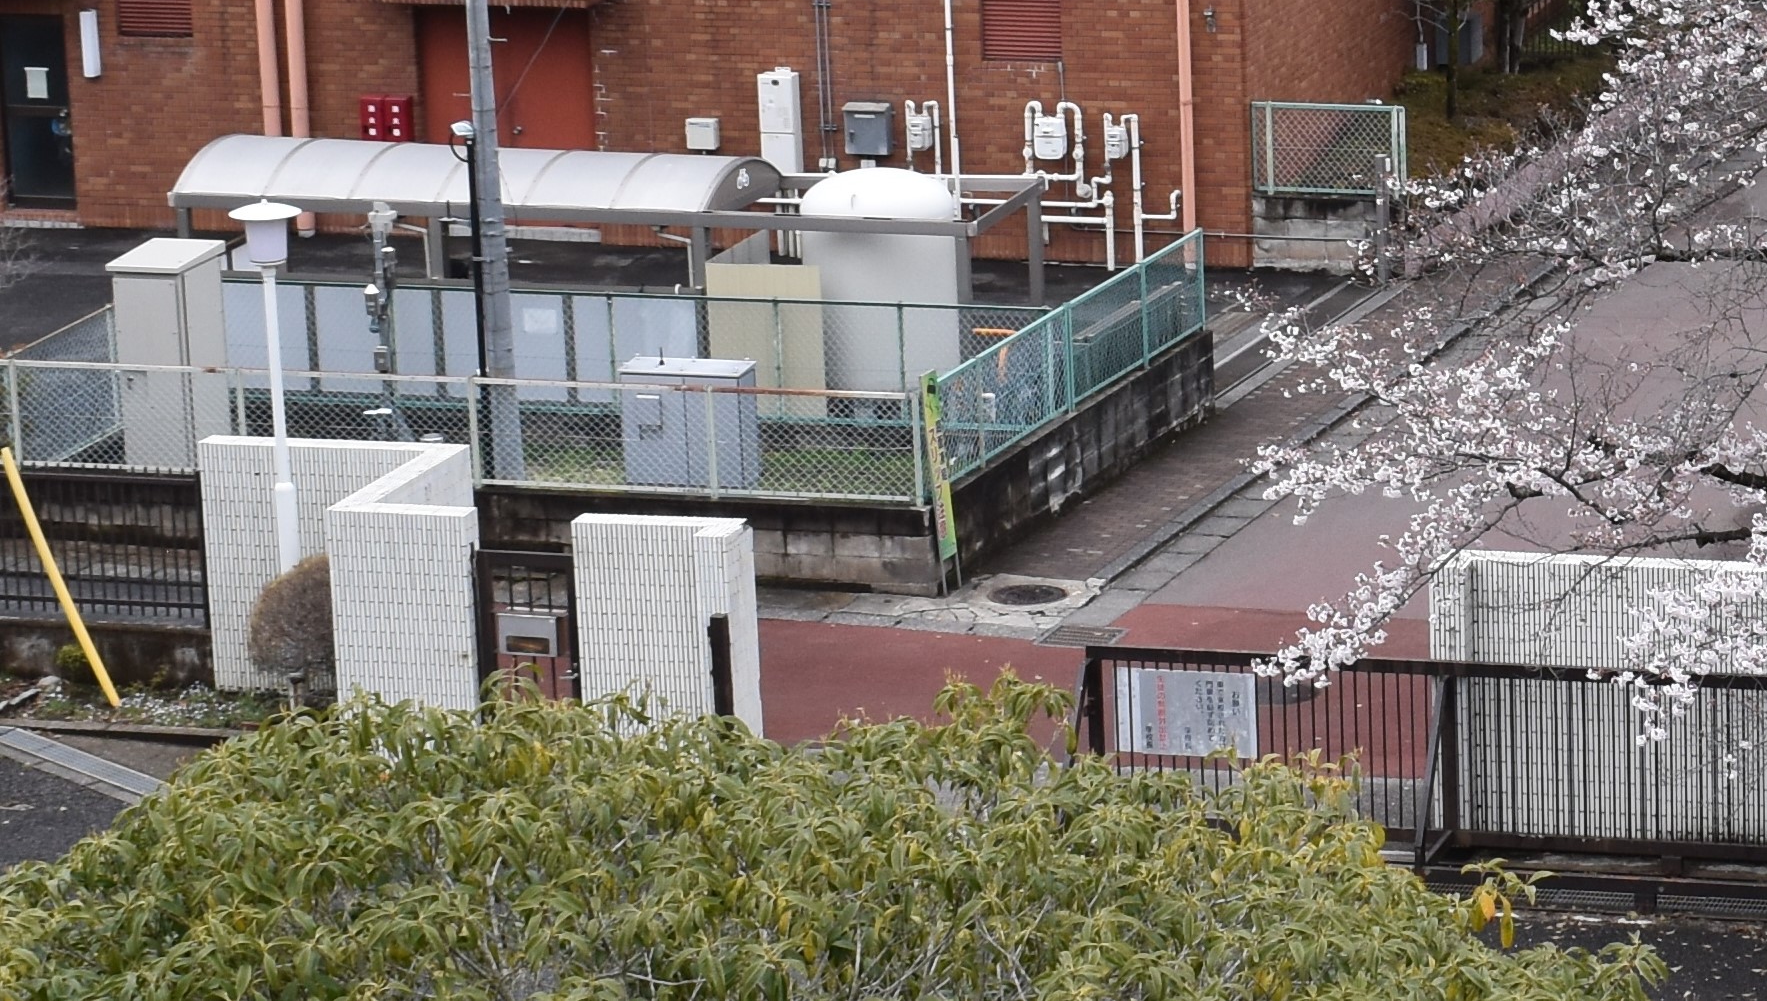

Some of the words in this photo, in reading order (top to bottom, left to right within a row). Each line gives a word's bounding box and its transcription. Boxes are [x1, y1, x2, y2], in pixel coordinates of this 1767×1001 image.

[1231, 691, 1240, 715] お願い
[1145, 725, 1154, 749] 学校長
